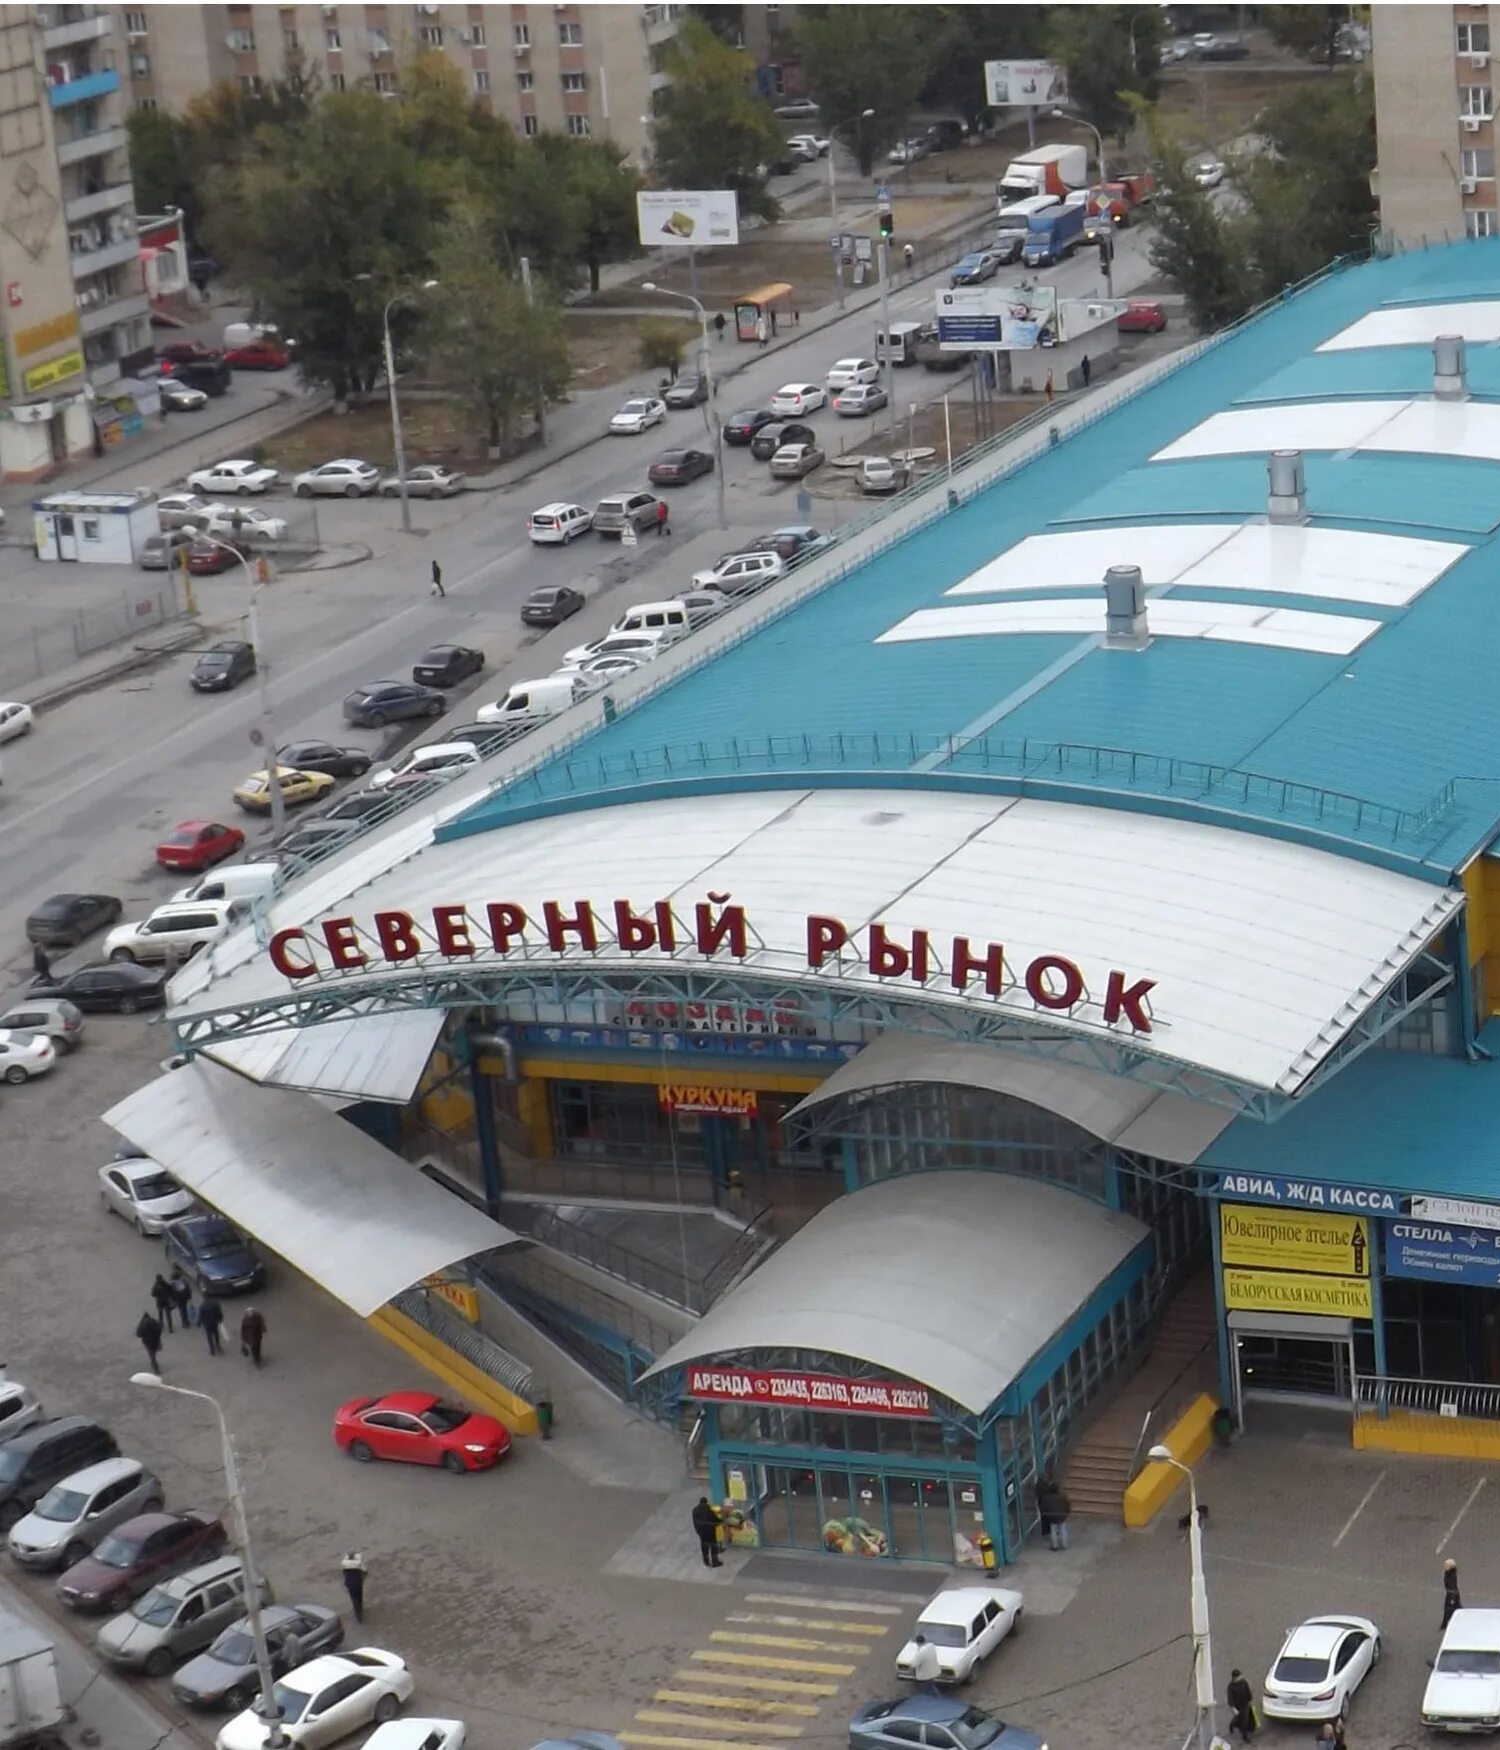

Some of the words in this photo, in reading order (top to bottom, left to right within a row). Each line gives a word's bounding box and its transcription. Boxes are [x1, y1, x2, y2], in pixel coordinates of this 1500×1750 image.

[269, 891, 747, 979] СЕВЕРНЫЙ
[806, 912, 1157, 1034] РЫНОК
[658, 1085, 757, 1108] КУРКУМА
[1223, 1175, 1281, 1200] АВИА,
[1287, 1183, 1324, 1205] Ж/Д
[1330, 1189, 1395, 1210] КАССА
[1224, 1214, 1302, 1246] Ювелирное
[1305, 1227, 1350, 1246] ателье
[1393, 1225, 1454, 1243] СТЕЛЛА
[1230, 1283, 1301, 1302] БЕЛОРУССКАЯ
[1303, 1288, 1369, 1308] КОСМЕТИКА
[693, 1373, 753, 1396] АРЕНДА
